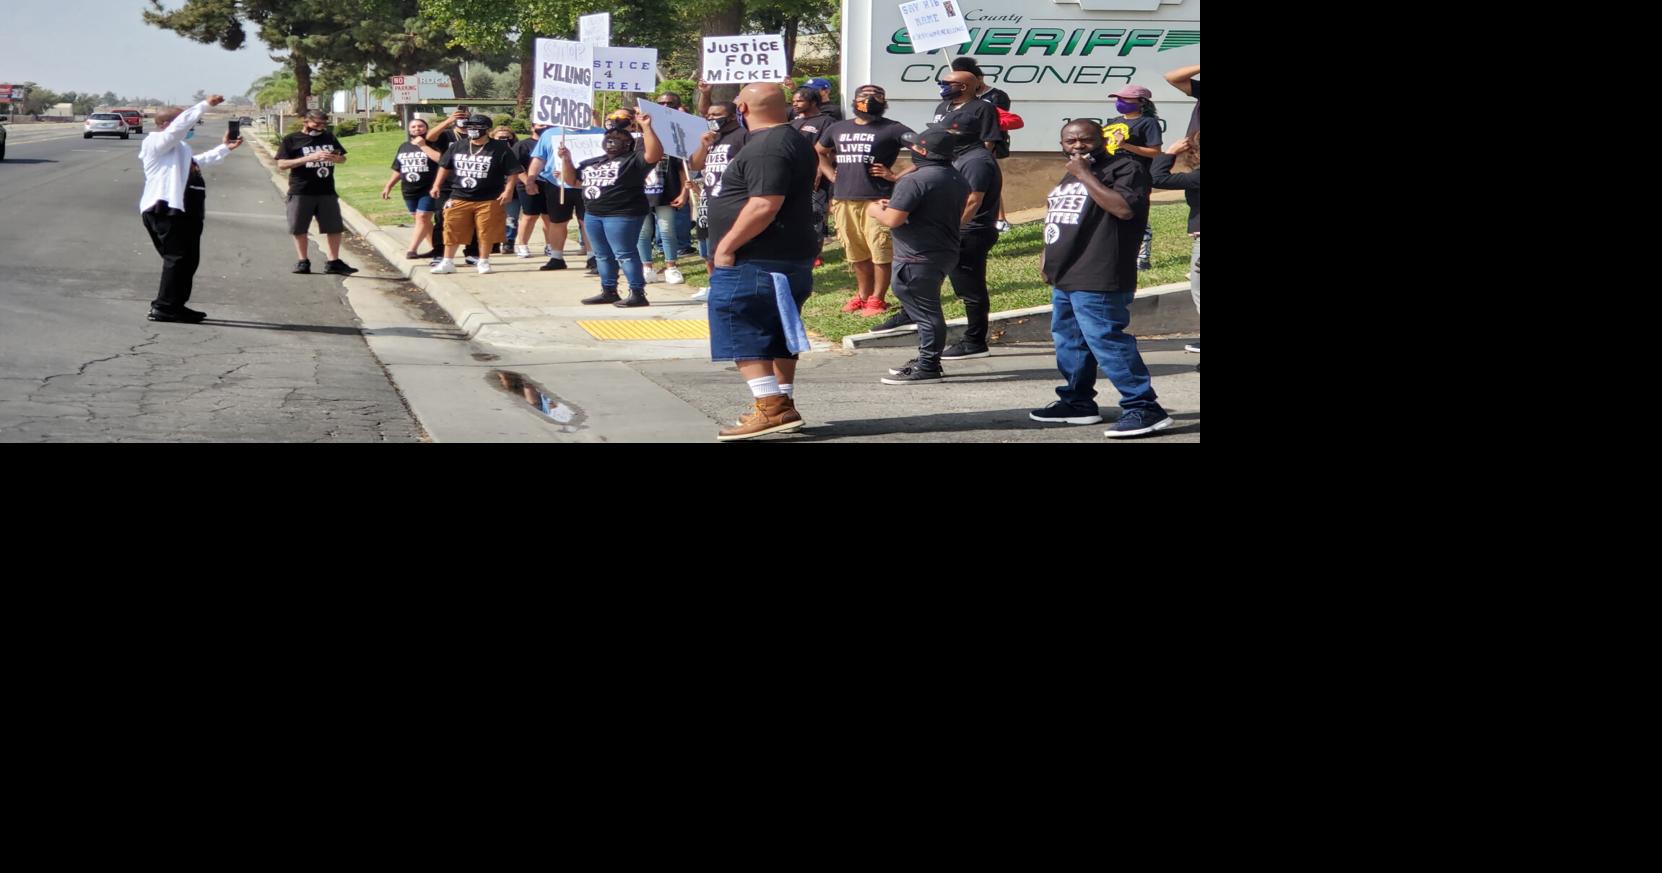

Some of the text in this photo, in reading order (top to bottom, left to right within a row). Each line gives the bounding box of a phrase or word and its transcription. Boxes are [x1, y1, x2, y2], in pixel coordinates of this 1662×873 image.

[964, 9, 1023, 23] County
[593, 60, 650, 70] STICE
[725, 53, 769, 67] FOR
[543, 62, 592, 86] KILLING
[604, 70, 612, 78] 4
[537, 95, 592, 128] SCARED
[839, 133, 875, 142] BLACK
[302, 145, 335, 155] BLACK
[840, 144, 872, 153] LIVES
[454, 153, 492, 163] BLACK
[706, 154, 726, 163] IVES
[456, 162, 489, 171] LIVES
